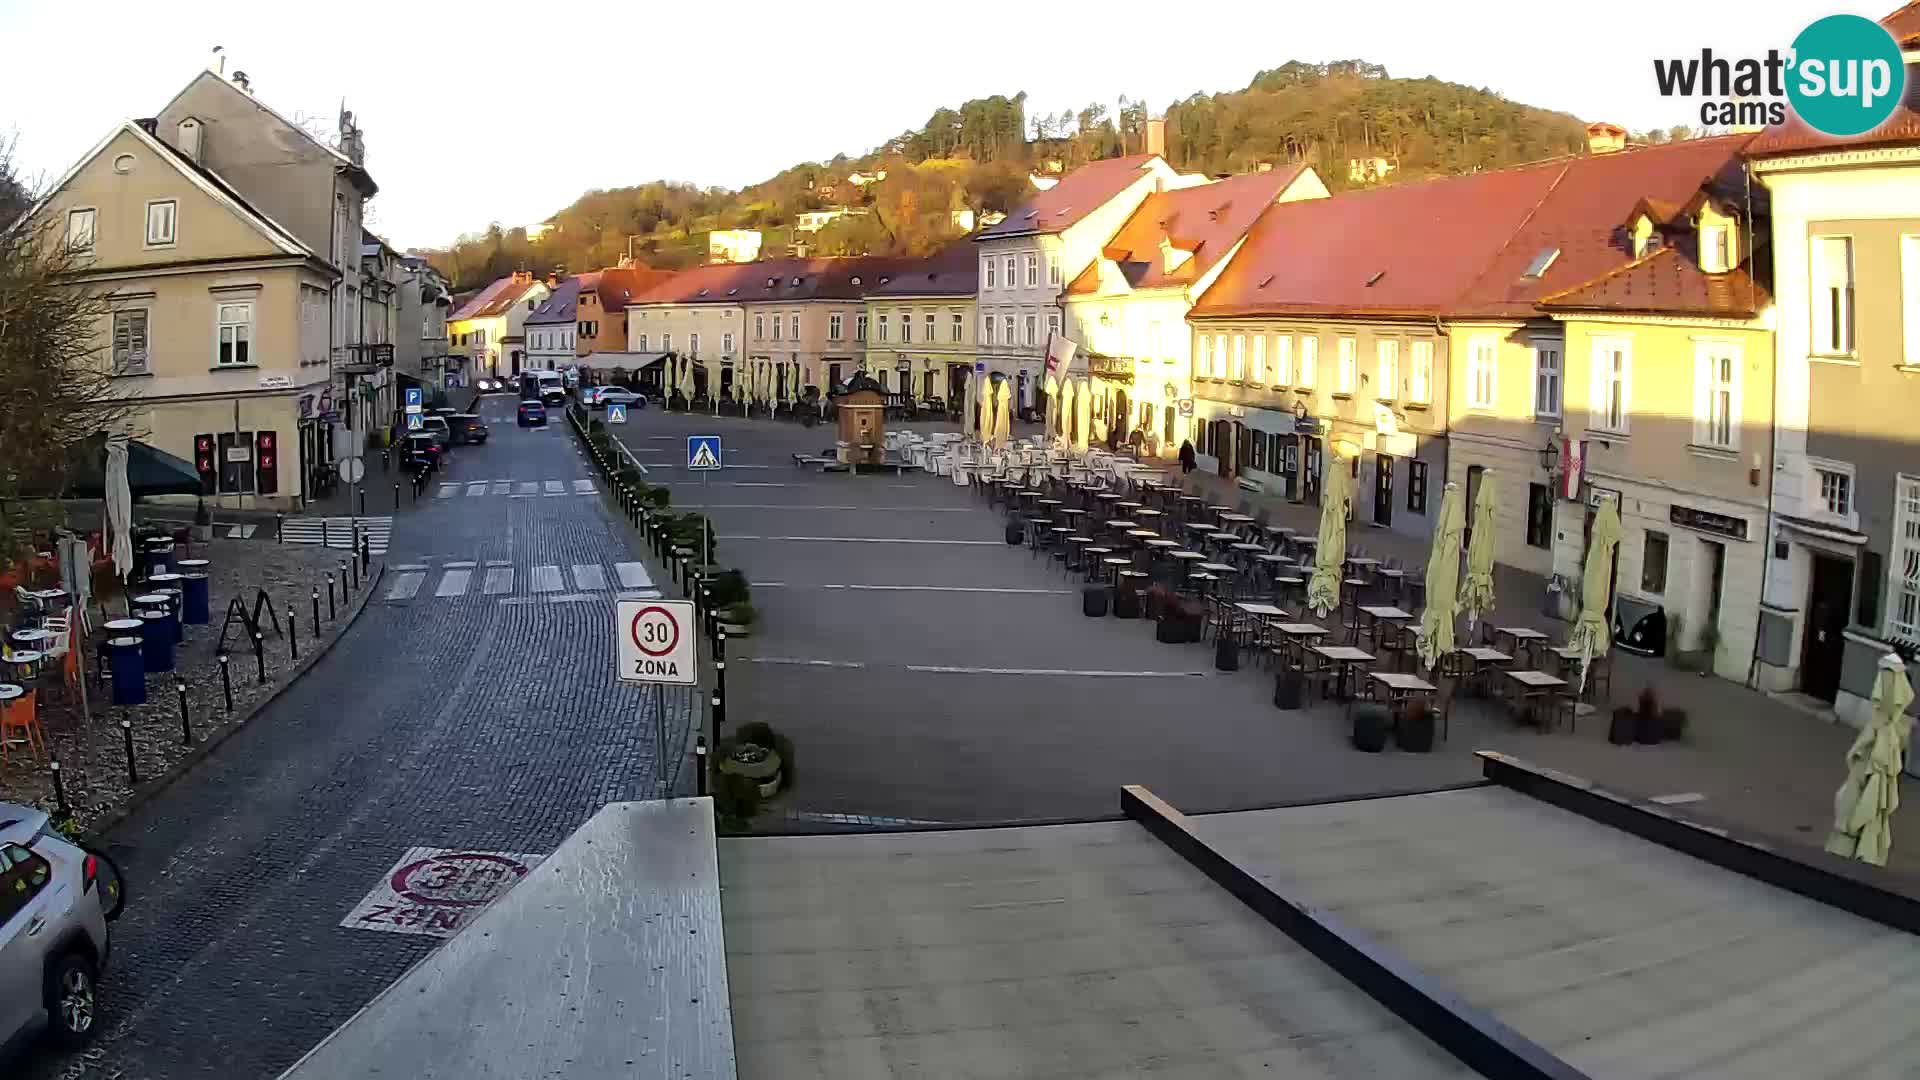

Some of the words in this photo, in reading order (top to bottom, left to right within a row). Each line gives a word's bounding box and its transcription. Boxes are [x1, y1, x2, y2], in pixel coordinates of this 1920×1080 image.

[409, 391, 418, 403] P
[644, 622, 668, 643] 30
[635, 659, 679, 677] ZONA
